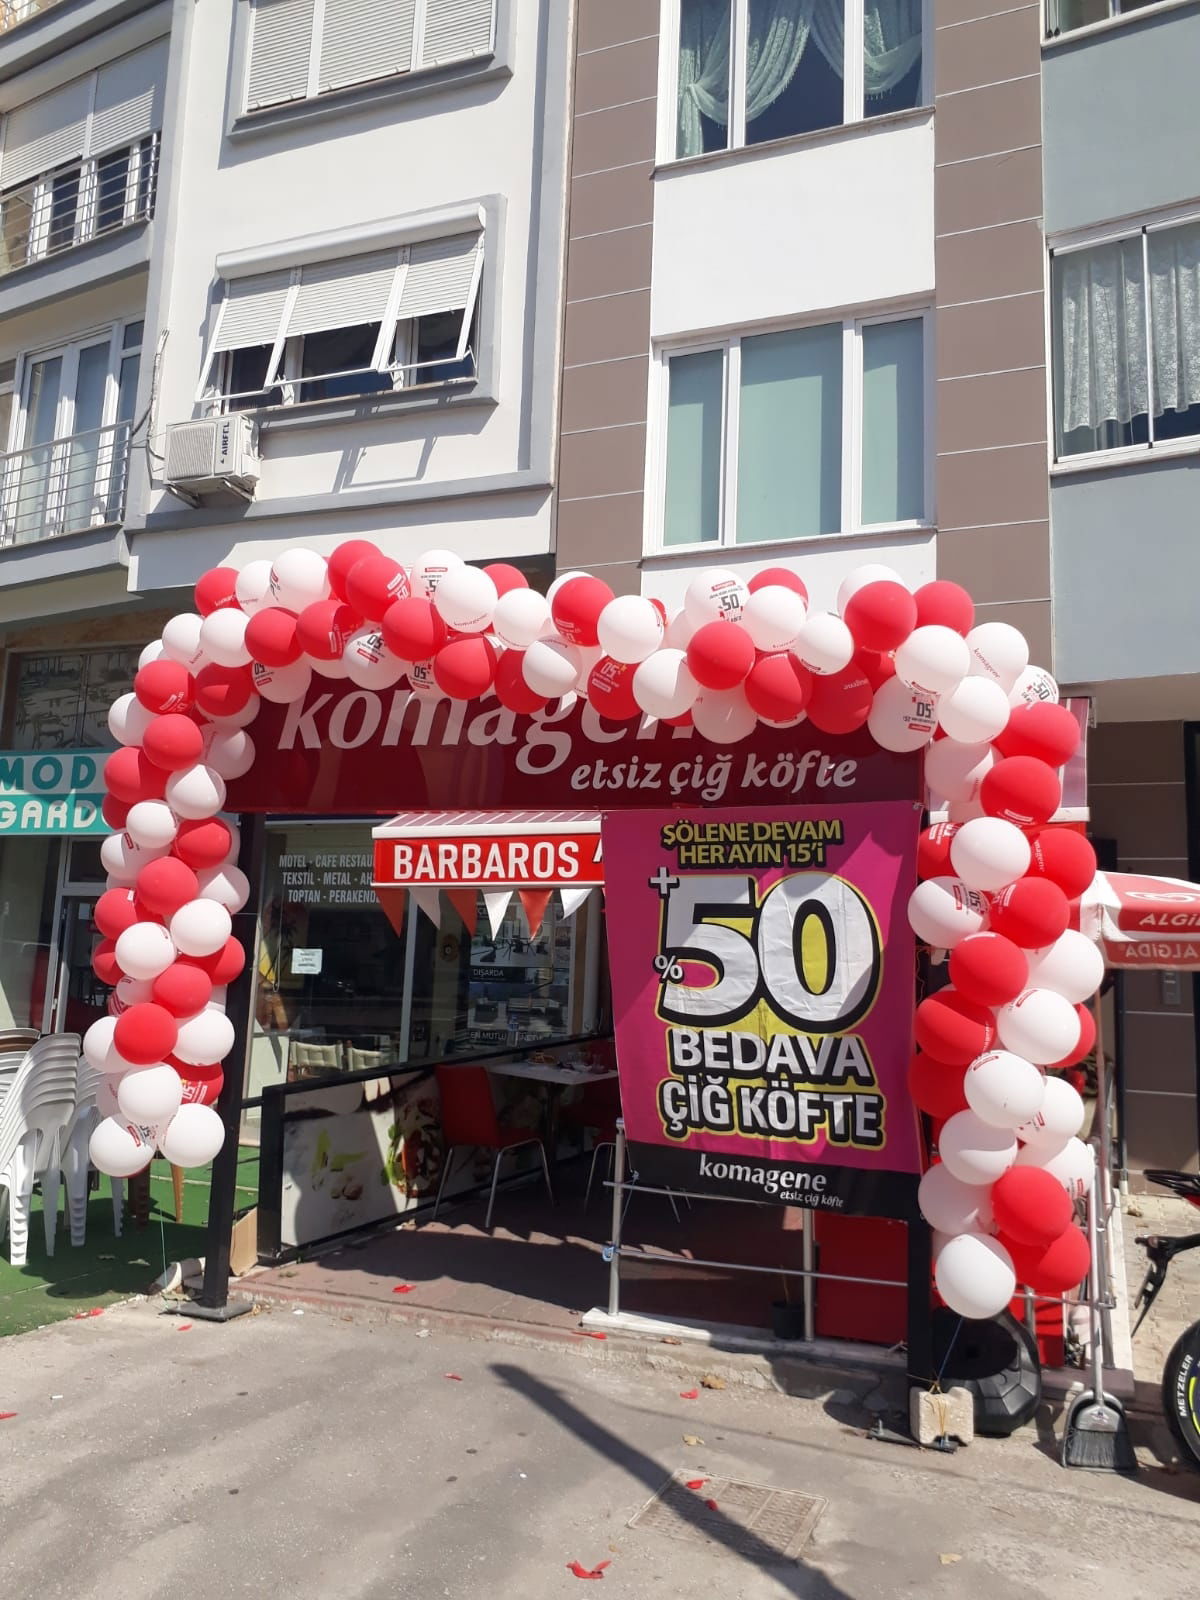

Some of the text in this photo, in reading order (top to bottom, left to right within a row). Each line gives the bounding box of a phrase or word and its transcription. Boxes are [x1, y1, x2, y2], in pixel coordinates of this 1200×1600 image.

[278, 689, 692, 775] komage
[0, 755, 97, 790] MOD
[571, 750, 857, 801] etsiz çiğ köfte
[0, 799, 108, 829] GARD
[662, 819, 841, 846] ŞÖLENE DEVAM
[279, 854, 307, 868] MOTEL
[315, 854, 337, 868] CAFE
[393, 841, 580, 880] BARBAROS
[680, 845, 725, 865] HER
[729, 844, 781, 864] AYIN
[288, 889, 321, 903] TOPTAN
[323, 871, 352, 885] METAL
[662, 872, 874, 1022] 50
[671, 1028, 872, 1078] BEDAVA
[662, 1074, 879, 1139] ÇİĞ KÖFTE
[699, 1153, 828, 1194] komagene
[779, 1190, 804, 1201] etsiz
[1176, 1354, 1194, 1417] METZELER
